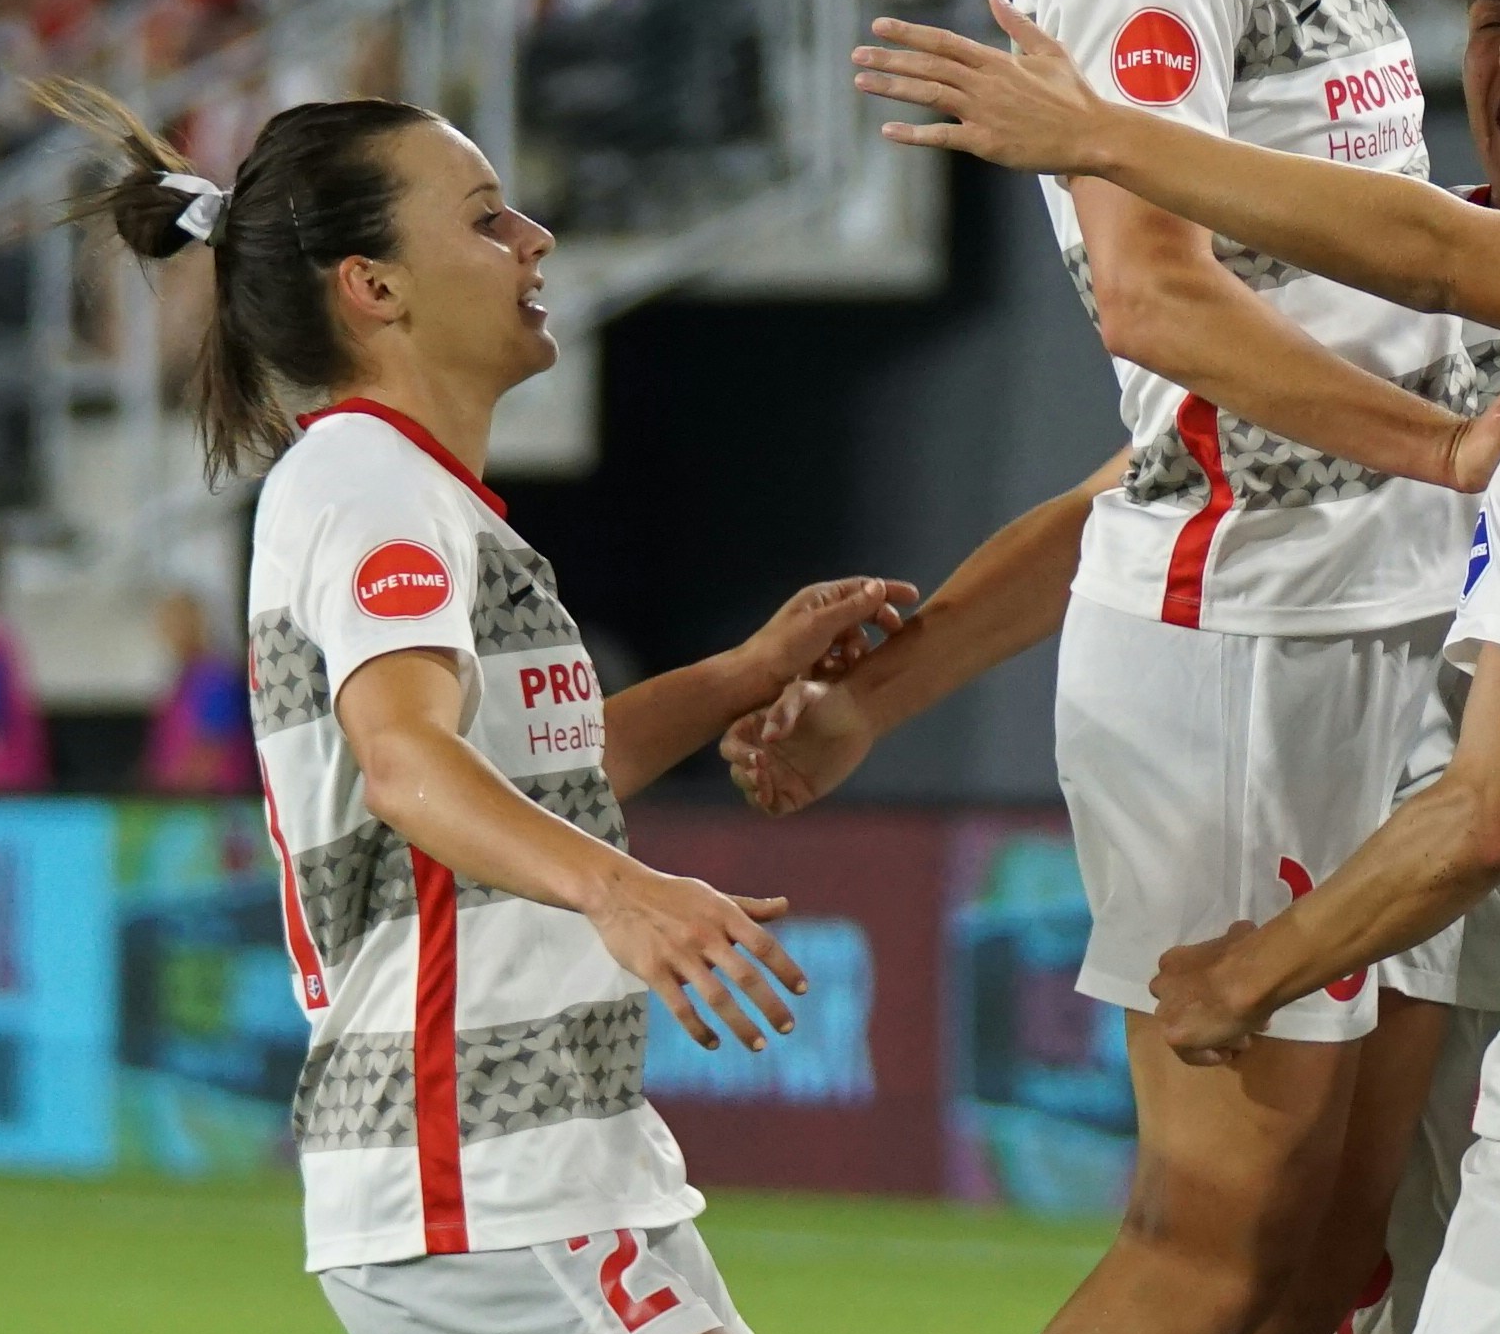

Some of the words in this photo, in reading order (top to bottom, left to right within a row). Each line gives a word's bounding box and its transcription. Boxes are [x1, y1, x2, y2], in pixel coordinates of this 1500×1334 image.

[1115, 46, 1193, 73] LIFETIME
[1328, 117, 1398, 163] Health
[1402, 115, 1415, 148] &
[359, 571, 447, 602] LIFETIME
[566, 1227, 683, 1334] 2
